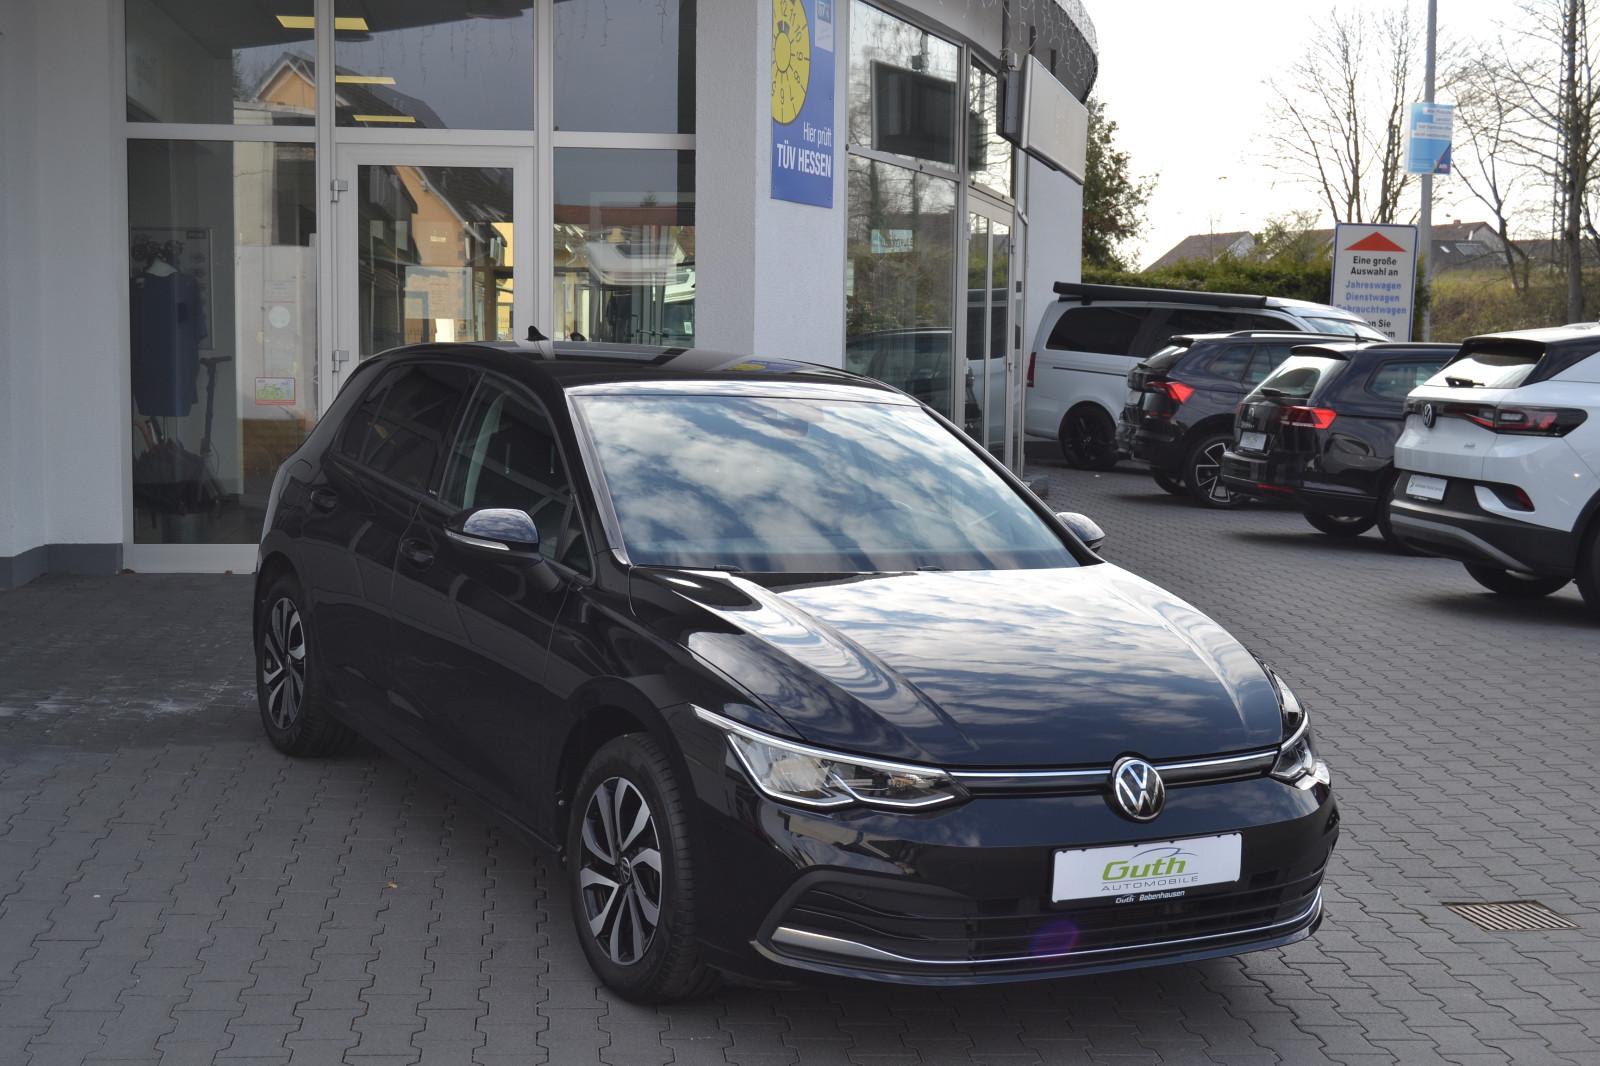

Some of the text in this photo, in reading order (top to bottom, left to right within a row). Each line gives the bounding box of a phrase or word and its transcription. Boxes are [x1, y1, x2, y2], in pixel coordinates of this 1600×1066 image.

[803, 121, 832, 149] Hier prüft
[776, 139, 832, 178] TÜV HESSEN
[1353, 255, 1396, 266] Eine große
[1350, 267, 1386, 276] Auswahl
[1346, 280, 1402, 291] Jahreswagen
[1346, 293, 1400, 303] Dienstwagen
[1378, 319, 1392, 328] Sie
[1102, 858, 1186, 881] Guth
[1101, 875, 1199, 892] AUTOMOBILE
[1115, 895, 1135, 904] Guth
